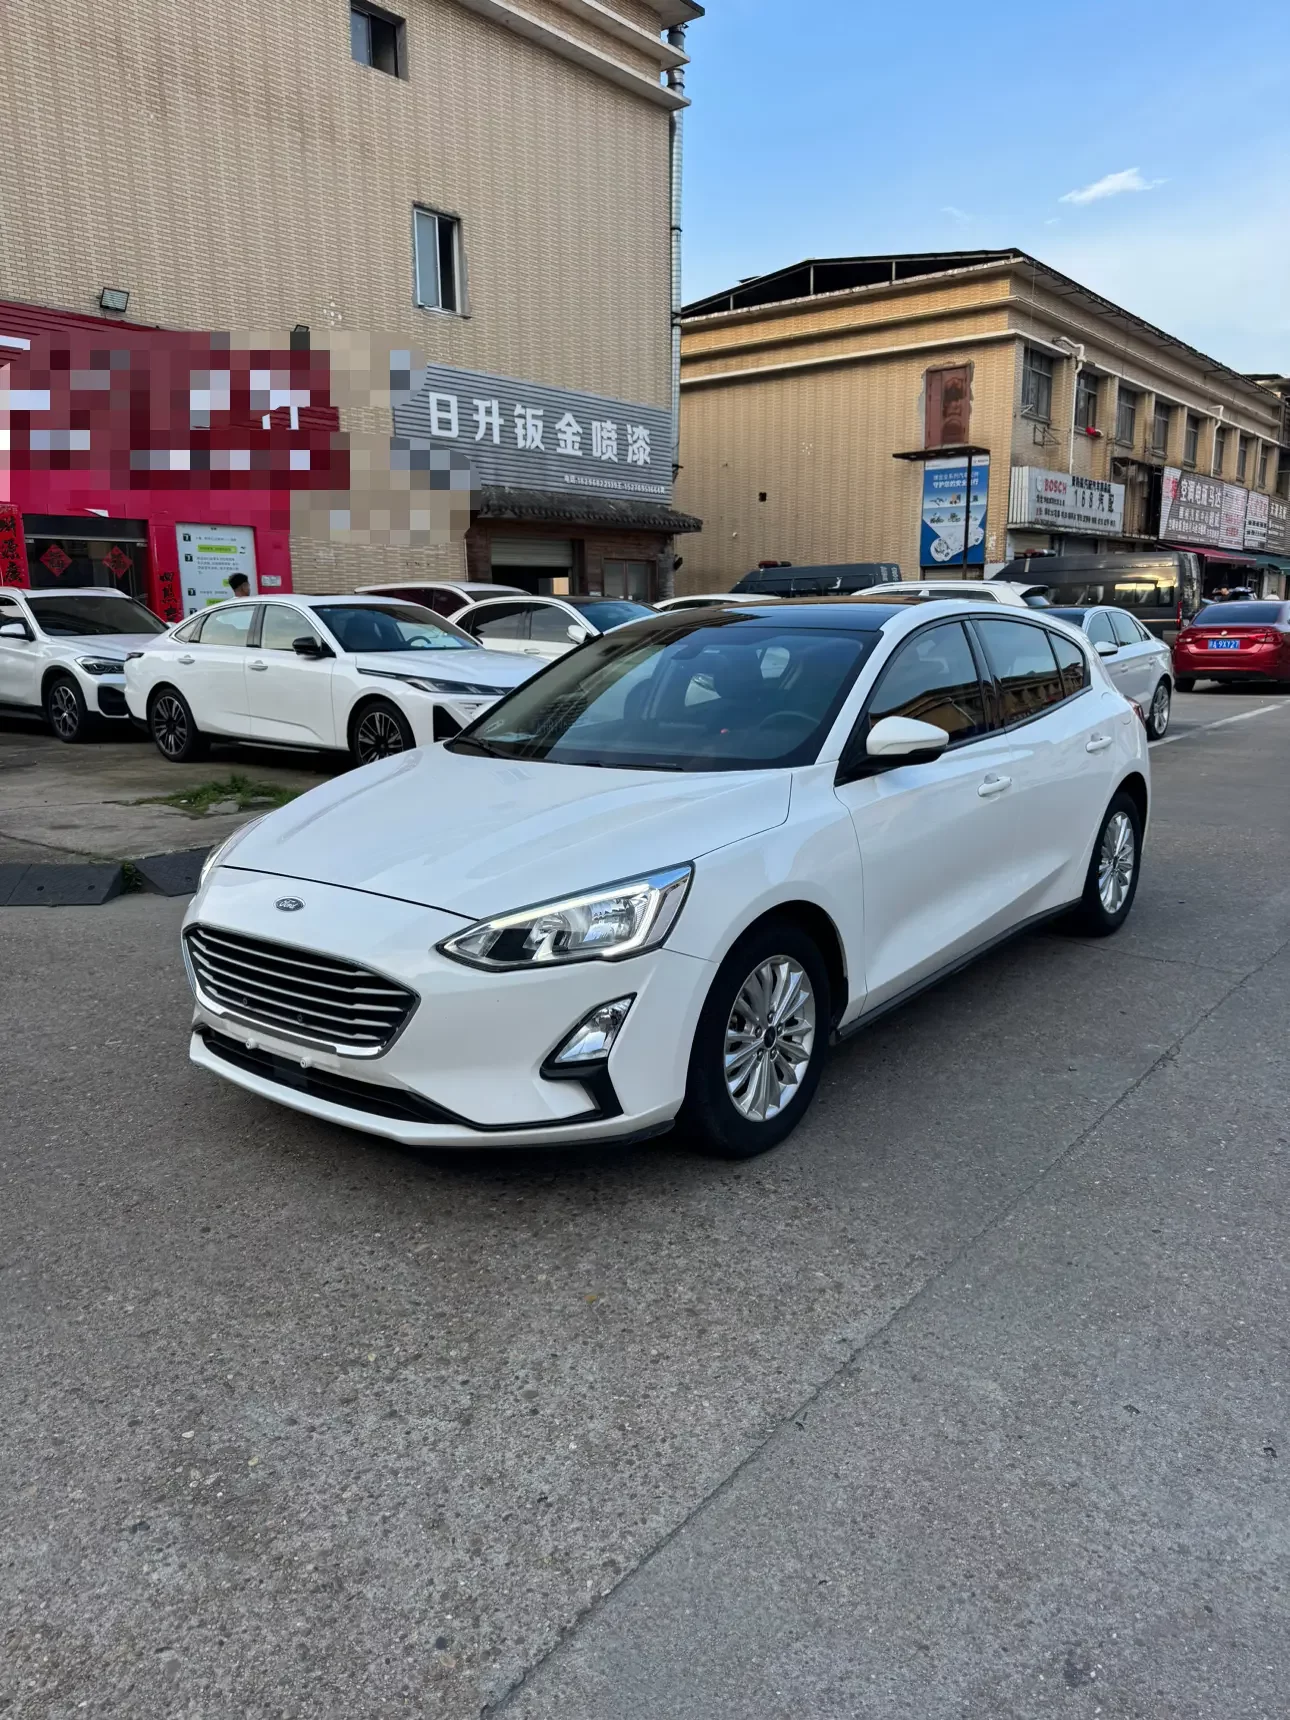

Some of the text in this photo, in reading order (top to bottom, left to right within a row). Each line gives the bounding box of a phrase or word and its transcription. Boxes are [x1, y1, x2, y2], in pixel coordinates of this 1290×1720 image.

[429, 392, 651, 465] 日升钣金喷漆
[932, 478, 979, 489] 守护您的安全行
[1043, 478, 1067, 494] BOSCH
